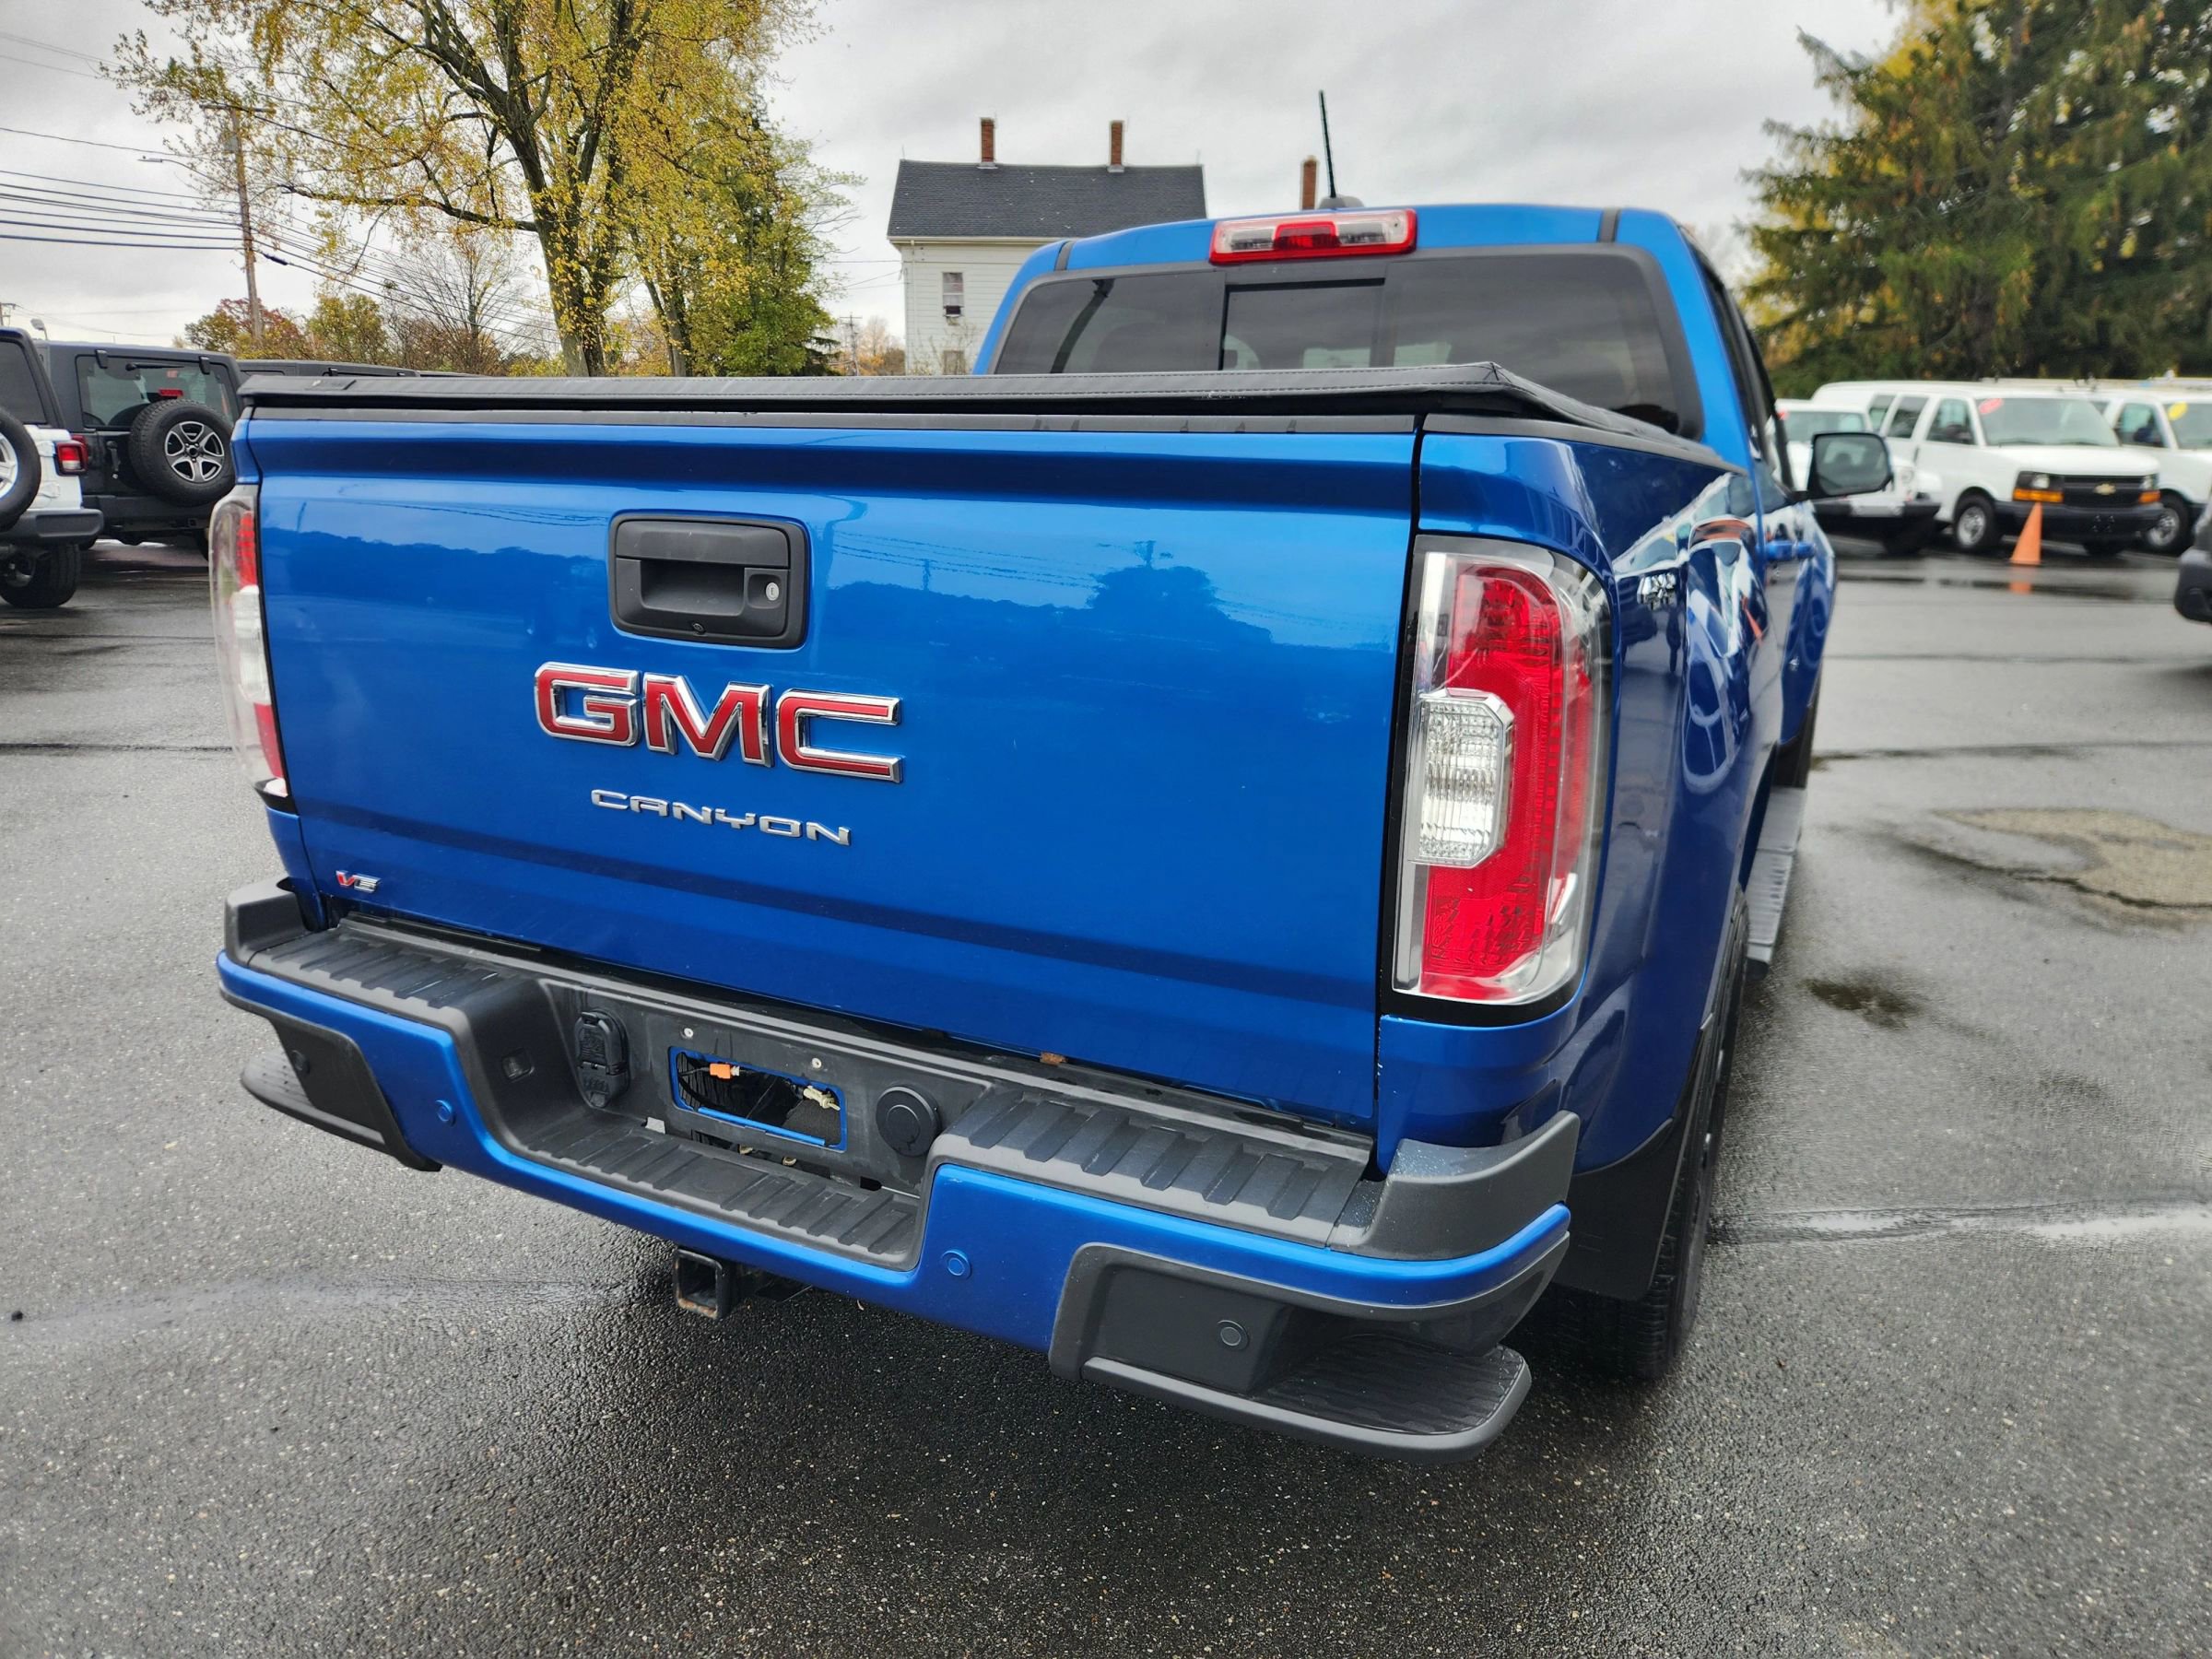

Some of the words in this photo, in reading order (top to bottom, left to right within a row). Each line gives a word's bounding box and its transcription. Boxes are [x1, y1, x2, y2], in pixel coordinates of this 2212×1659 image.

[534, 661, 903, 783] GMC
[591, 789, 852, 846] CANYON
[335, 869, 381, 893] V6
